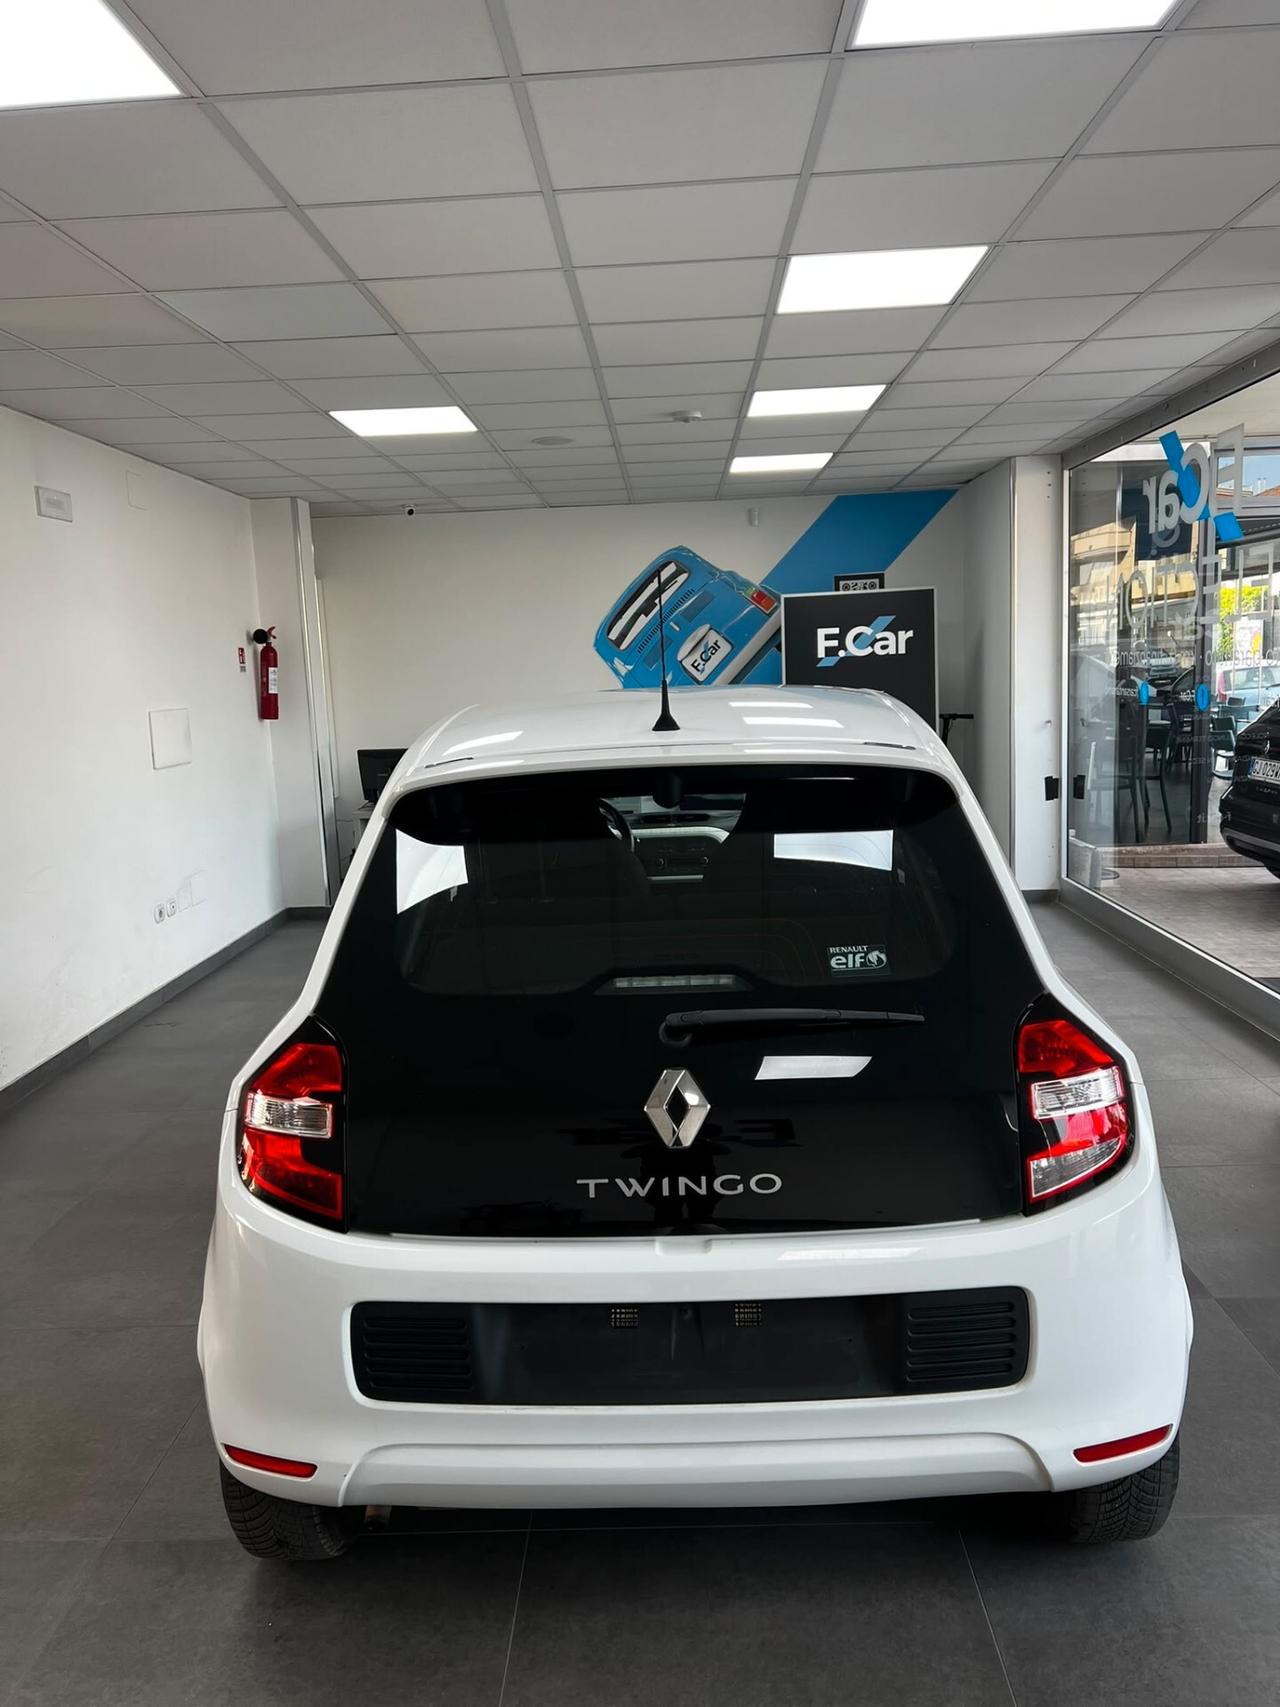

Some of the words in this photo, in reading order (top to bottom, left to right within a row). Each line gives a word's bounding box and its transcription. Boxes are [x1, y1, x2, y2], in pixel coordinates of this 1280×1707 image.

[816, 625, 914, 659] F.Car
[690, 638, 722, 674] F.Car
[829, 945, 869, 954] RENAULT
[830, 954, 866, 970] elf
[576, 1173, 783, 1199] TWINGO
